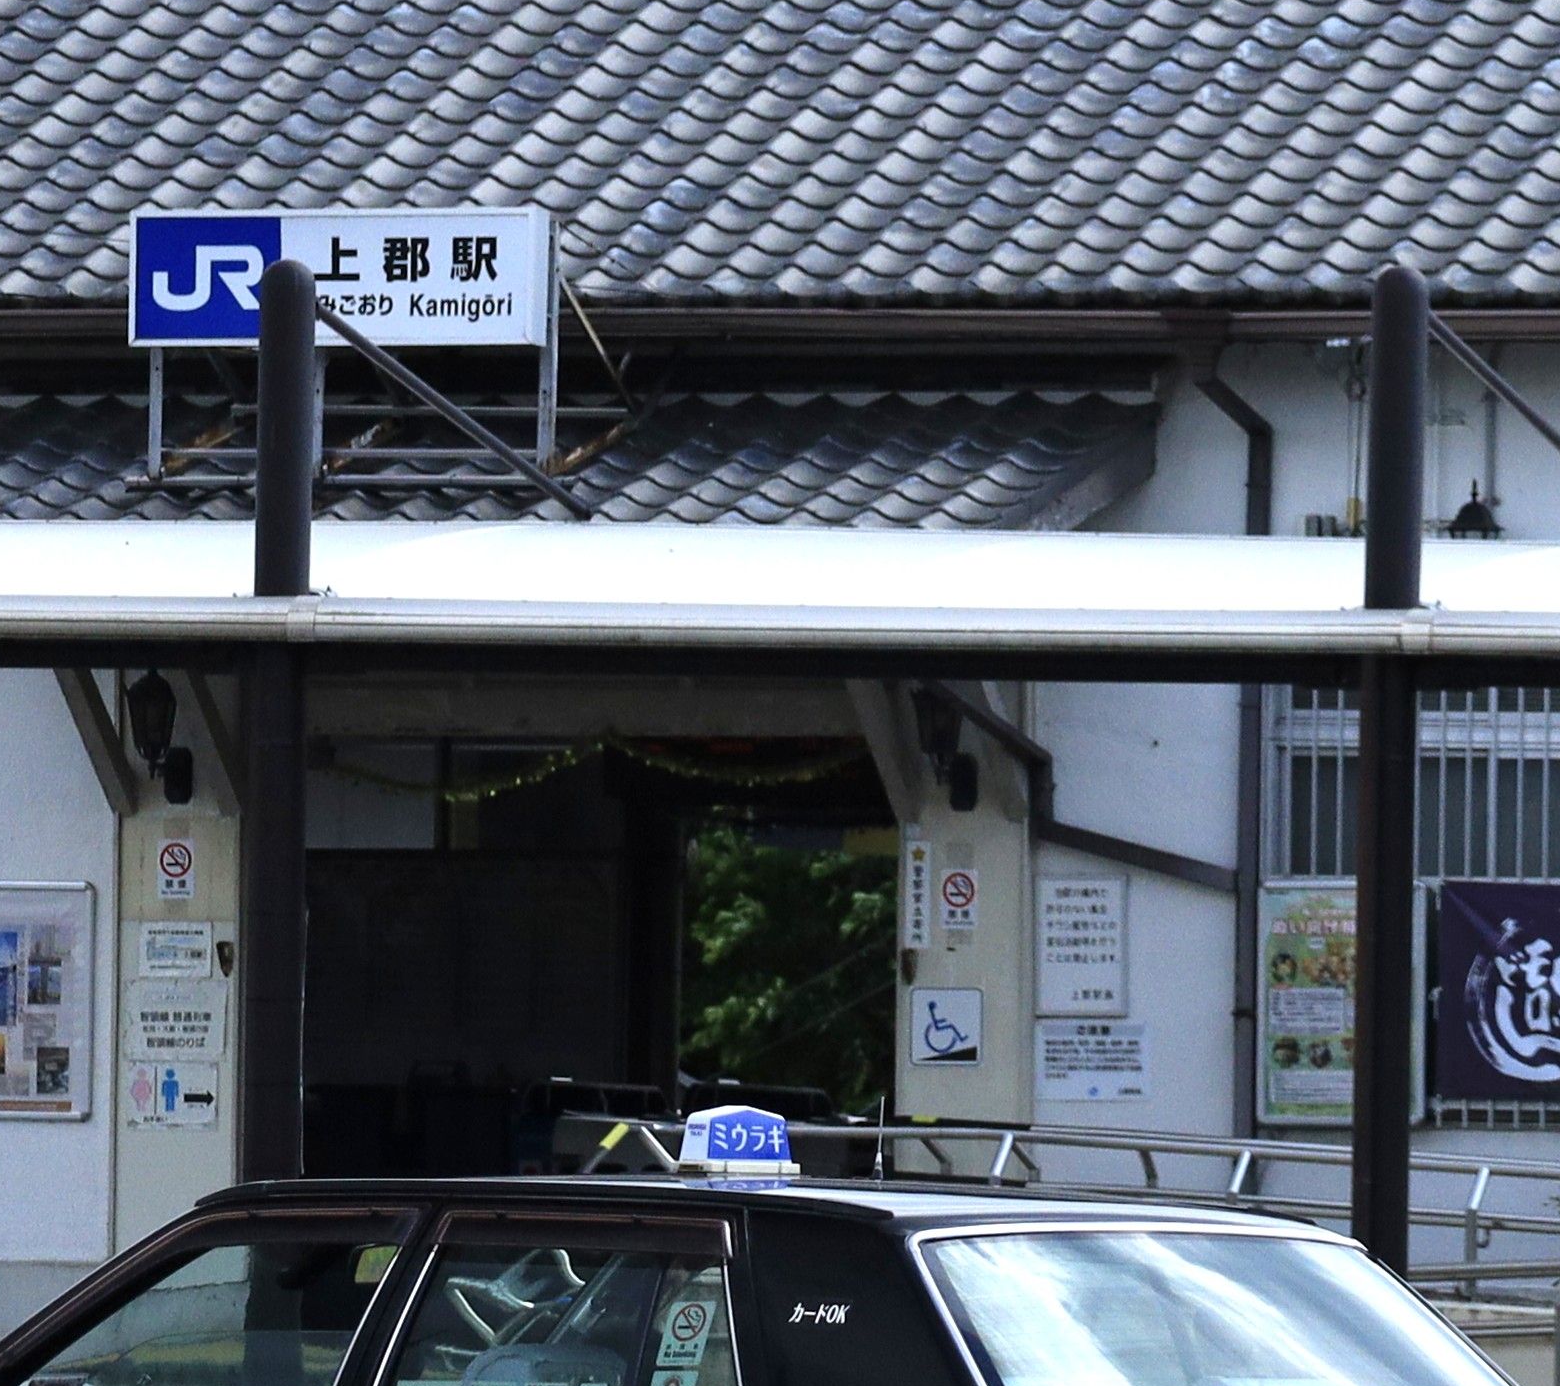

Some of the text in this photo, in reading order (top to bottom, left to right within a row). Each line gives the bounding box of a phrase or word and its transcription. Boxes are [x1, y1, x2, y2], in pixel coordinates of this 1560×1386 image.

[314, 236, 498, 283] 上郡駅
[152, 244, 265, 312] JR
[316, 294, 394, 315] みごおり
[410, 292, 513, 323] Kamigōri
[714, 1123, 785, 1153] ミウラギ
[789, 1302, 850, 1324] カードOK
